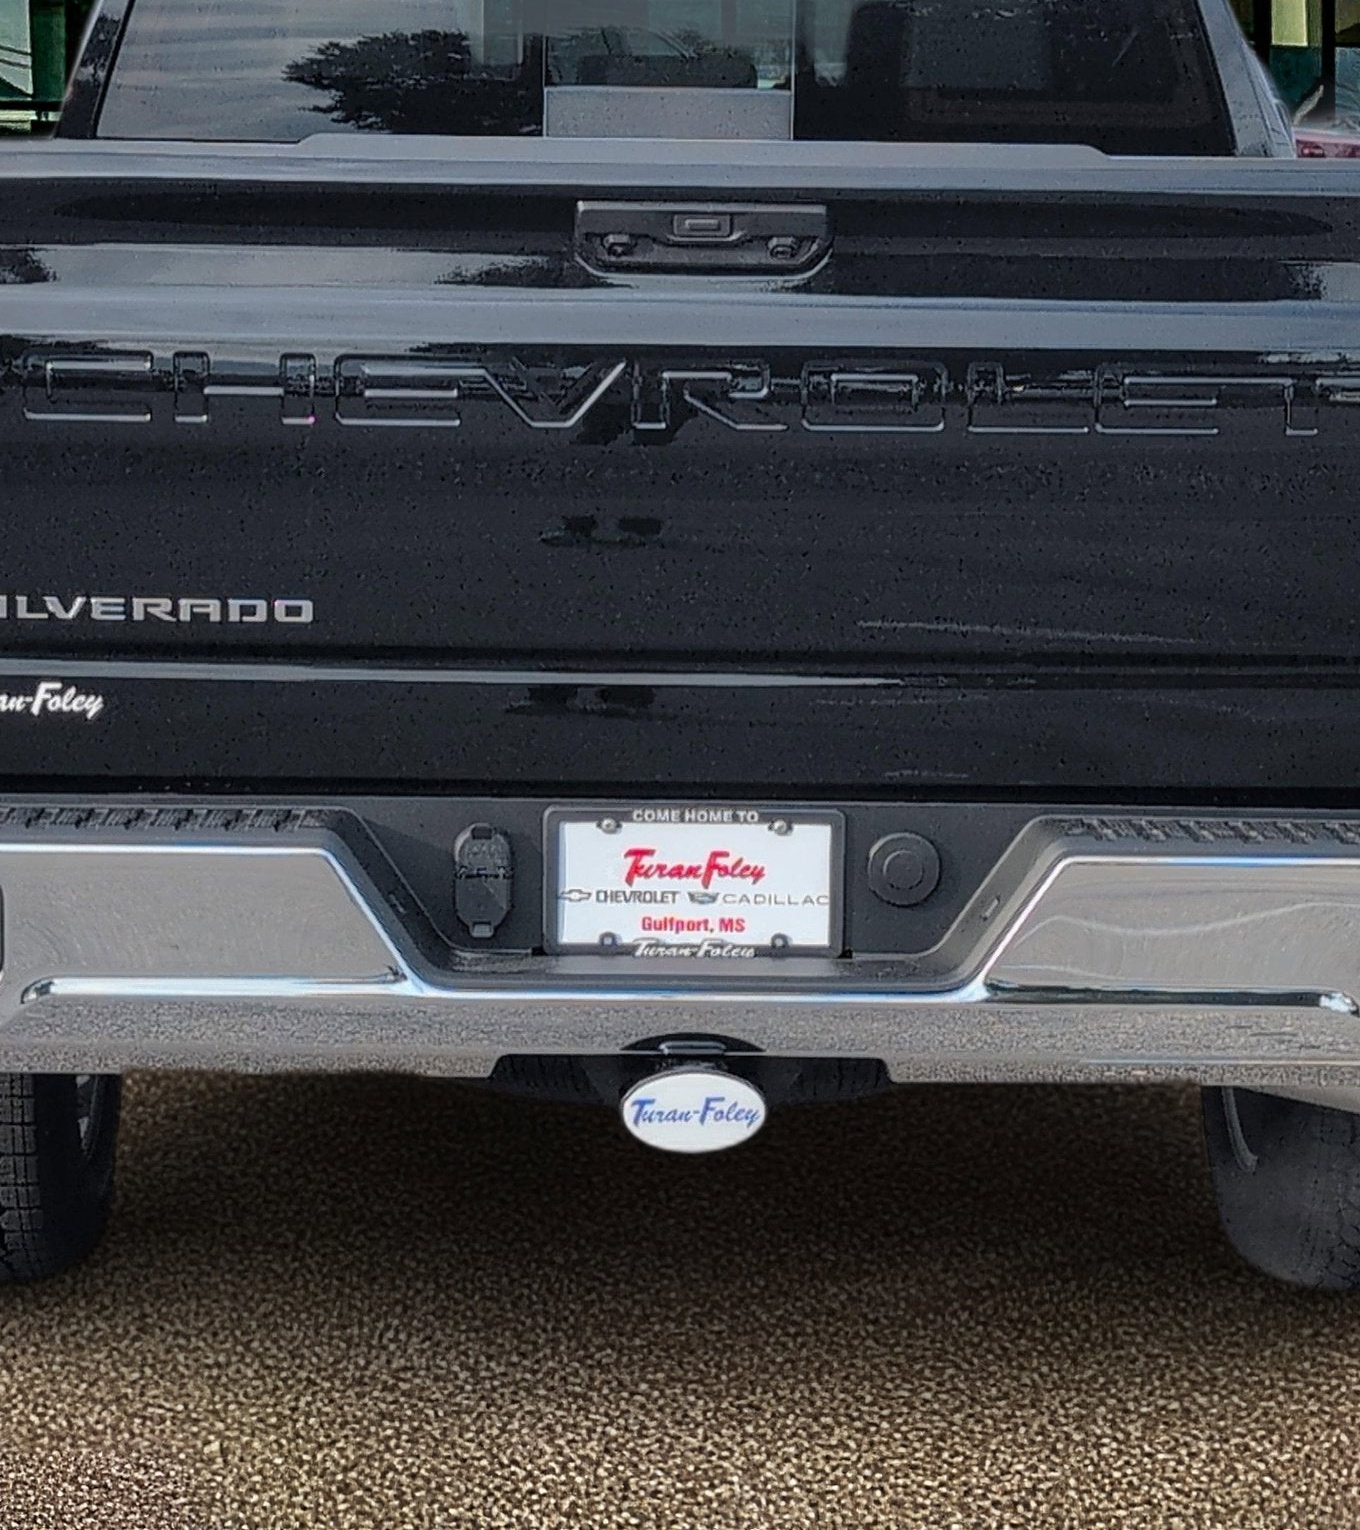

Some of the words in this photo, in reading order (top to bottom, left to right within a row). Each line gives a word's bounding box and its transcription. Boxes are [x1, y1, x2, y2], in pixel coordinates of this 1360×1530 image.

[633, 810, 680, 822] COME
[685, 810, 733, 822] HOME
[736, 811, 759, 822] TO
[596, 890, 680, 904] CHEVROLET
[723, 893, 830, 905] CADILLAC
[641, 916, 715, 934] Gulfport,
[720, 917, 746, 933] MS
[632, 1097, 760, 1128] Turan-Foley
